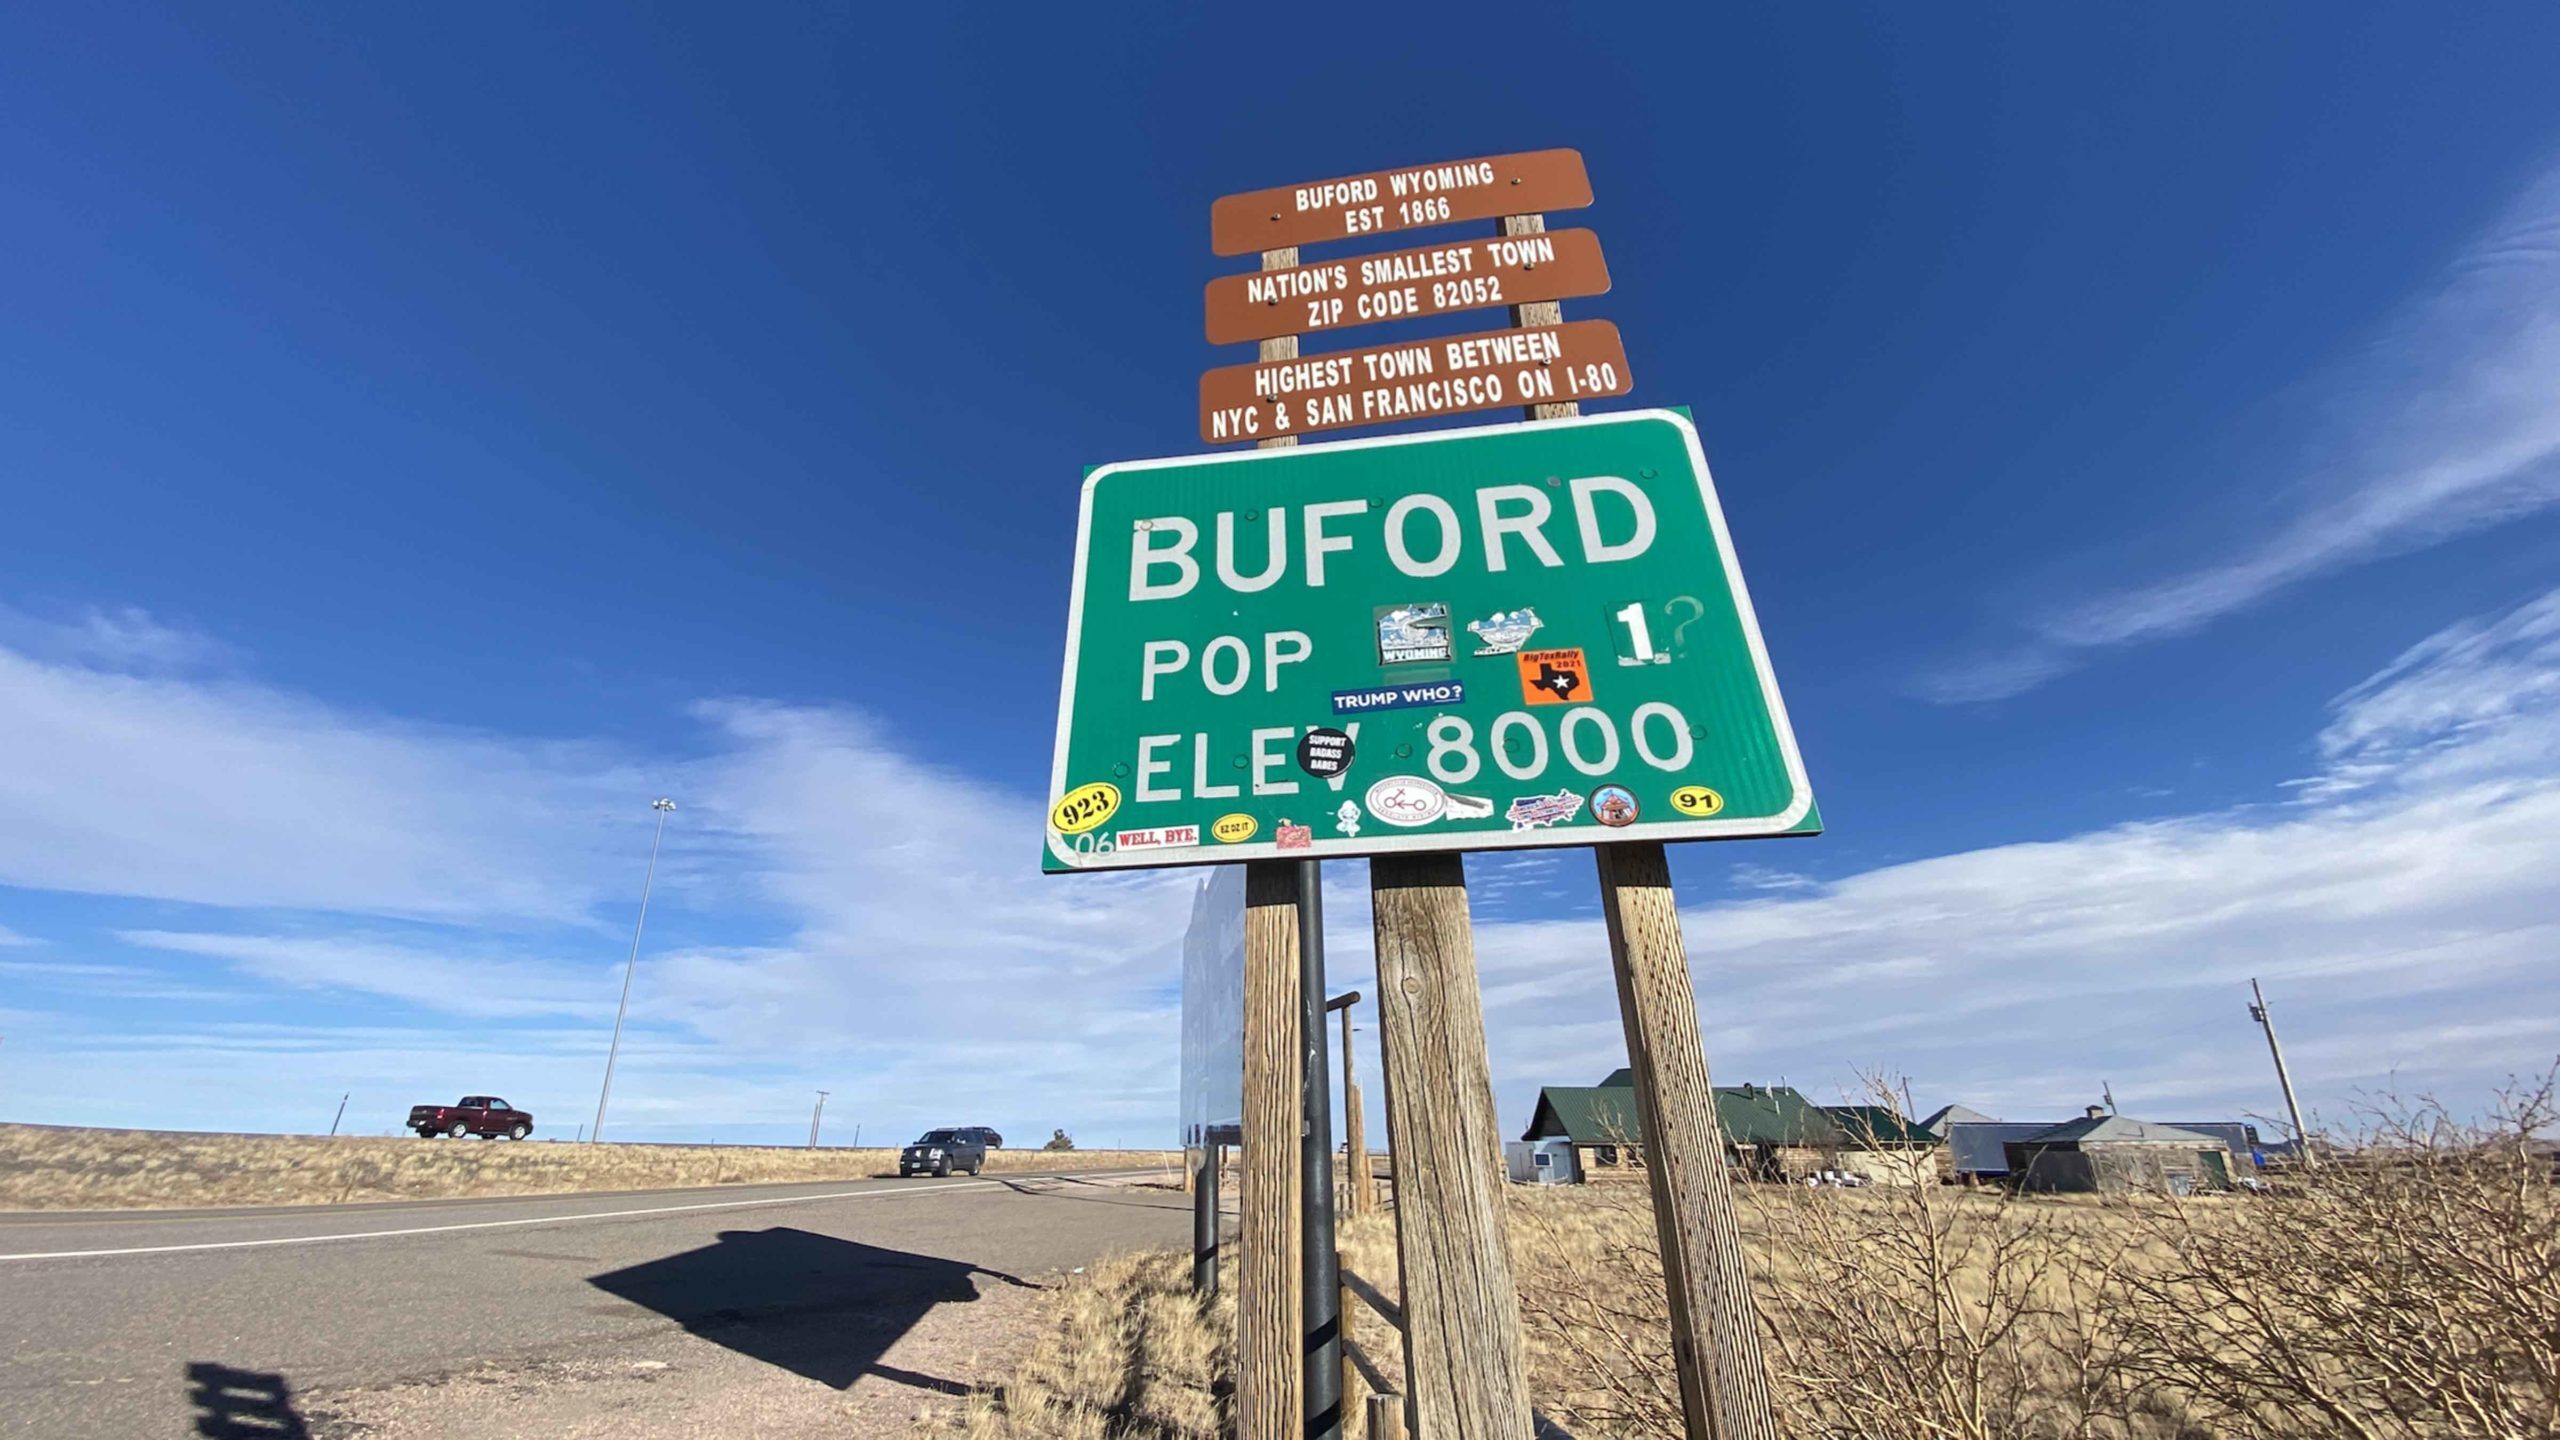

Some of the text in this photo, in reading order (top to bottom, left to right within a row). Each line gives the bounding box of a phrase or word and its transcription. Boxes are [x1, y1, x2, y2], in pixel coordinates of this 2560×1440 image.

[1296, 162, 1494, 212] BUFORD WYOMING
[1346, 197, 1451, 233] EST 1866
[1247, 237, 1555, 302] NATION'S SMALLEST TOWN
[1308, 275, 1503, 327] ZIP CODE 82052
[1255, 332, 1561, 396] HIGHEST TOWN BETWEEN
[1212, 361, 1617, 439] NYC & SAN FRANCISCO ON I-80
[1129, 476, 1657, 602] BUFORD
[1141, 602, 1654, 700] POP 1
[1382, 647, 1447, 661] WYOMING
[1334, 685, 1463, 709] TRUMP WHO?
[1308, 735, 1347, 747] SUPPORT
[1309, 747, 1342, 759] BADASS
[1427, 703, 1693, 784] 8000
[1310, 760, 1338, 771] BABES
[1063, 791, 1110, 826] 923
[1680, 793, 1713, 808] 91
[1074, 831, 1115, 855] 06
[1119, 828, 1198, 846] WELL, BYE.
